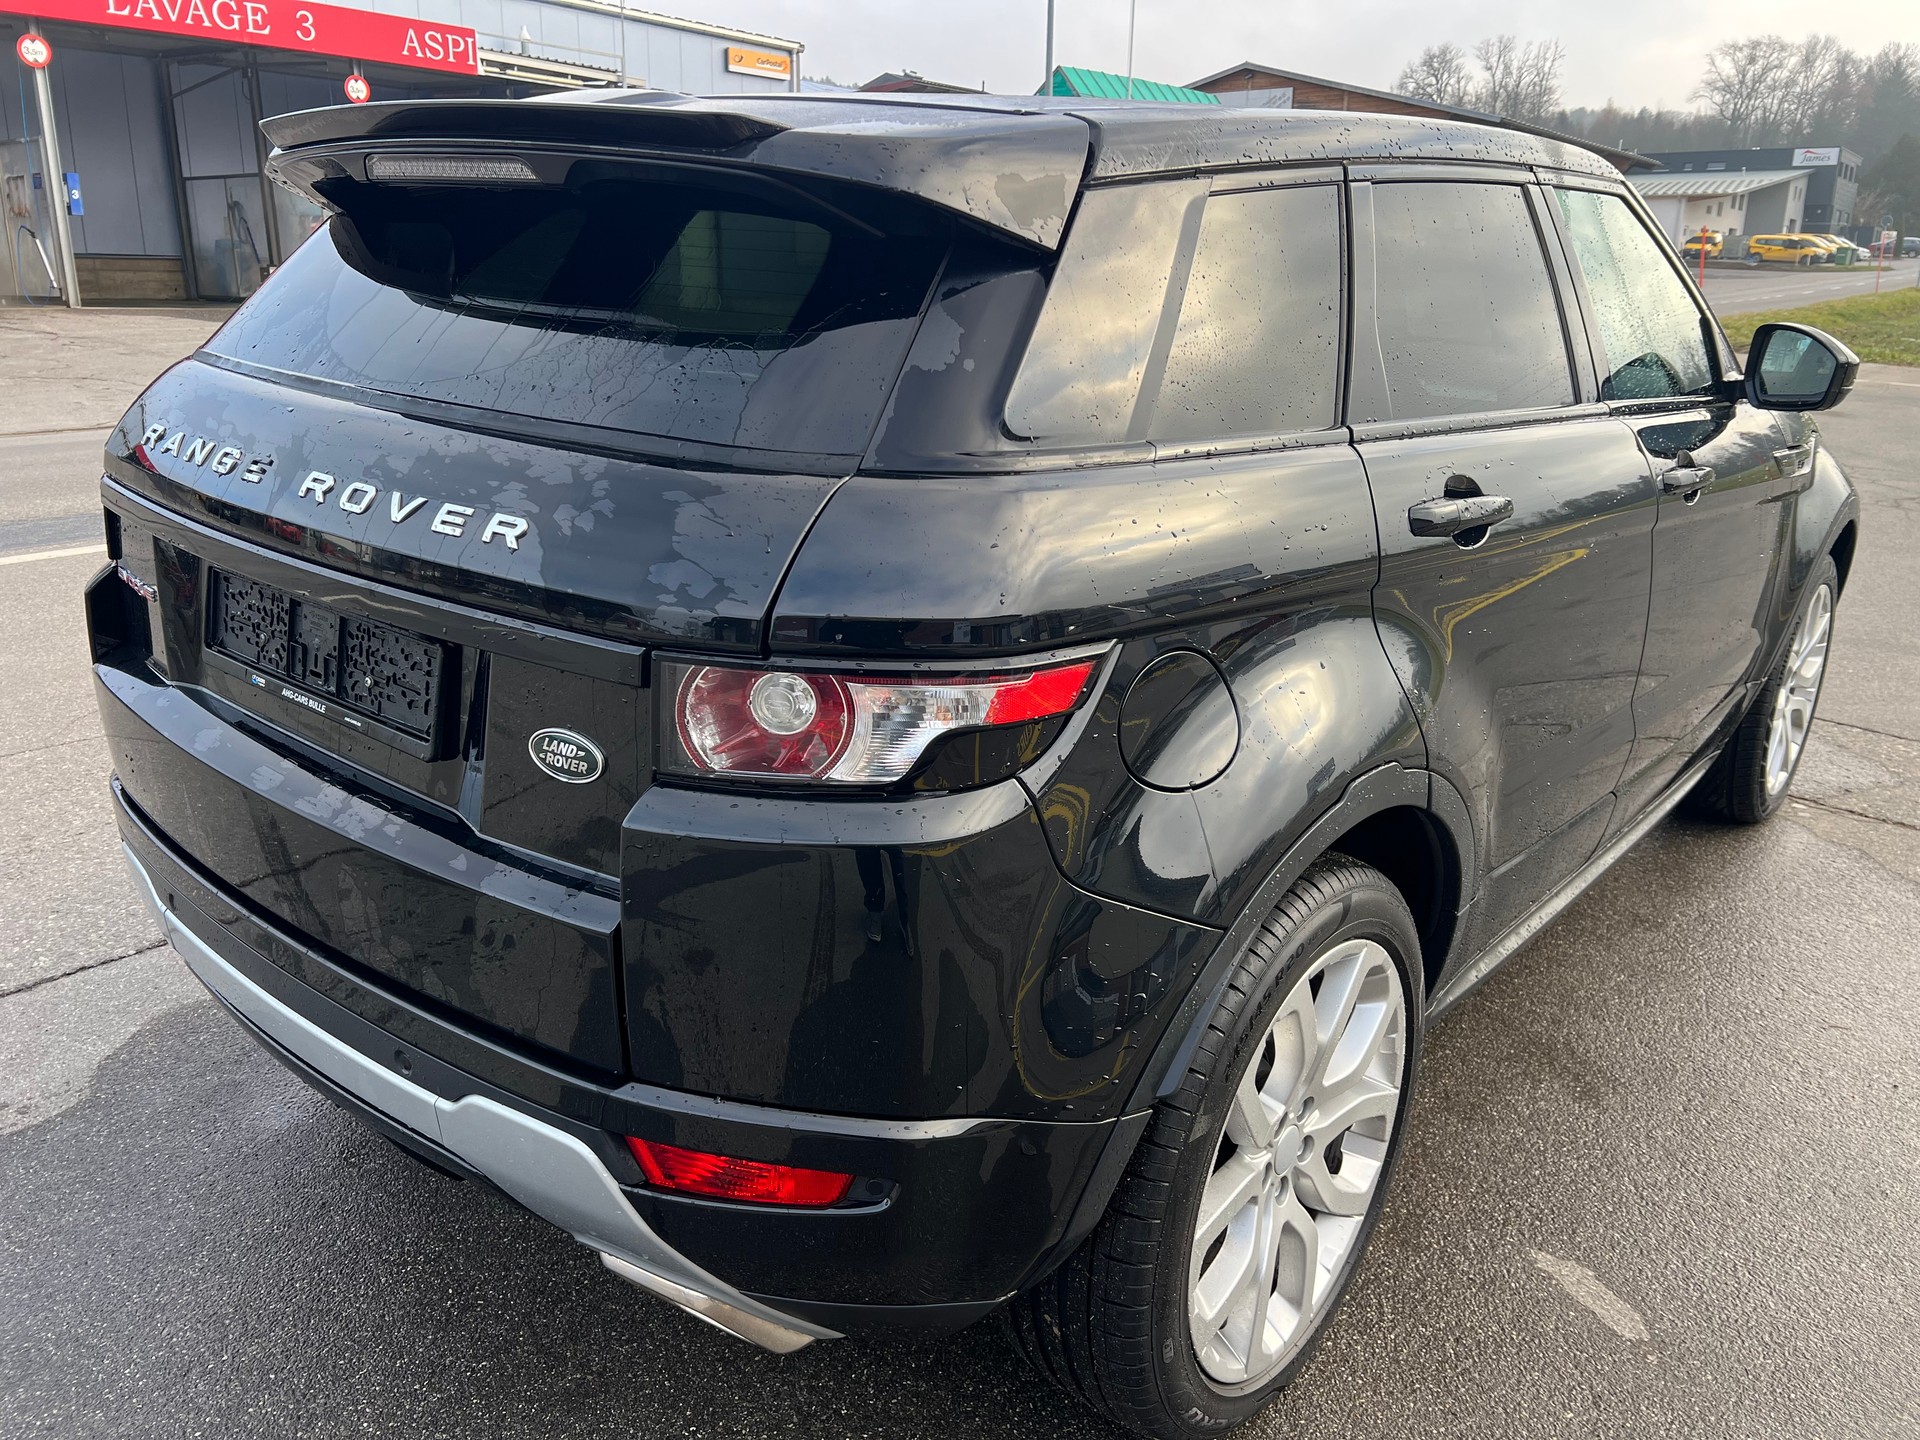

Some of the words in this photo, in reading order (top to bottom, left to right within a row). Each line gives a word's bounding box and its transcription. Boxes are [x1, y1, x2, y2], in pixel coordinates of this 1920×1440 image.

[106, 0, 271, 35] LAVAGE
[295, 10, 316, 41] 3
[401, 27, 476, 65] ASPI
[1800, 154, 1831, 164] James
[71, 189, 80, 200] 3
[140, 423, 274, 485] RANGE
[298, 470, 529, 550] ROVER
[281, 688, 309, 706] AHG-CARS
[308, 699, 327, 714] BULLE
[542, 737, 578, 758] LAND
[545, 752, 588, 774] ROVER
[1274, 942, 1305, 988] R20
